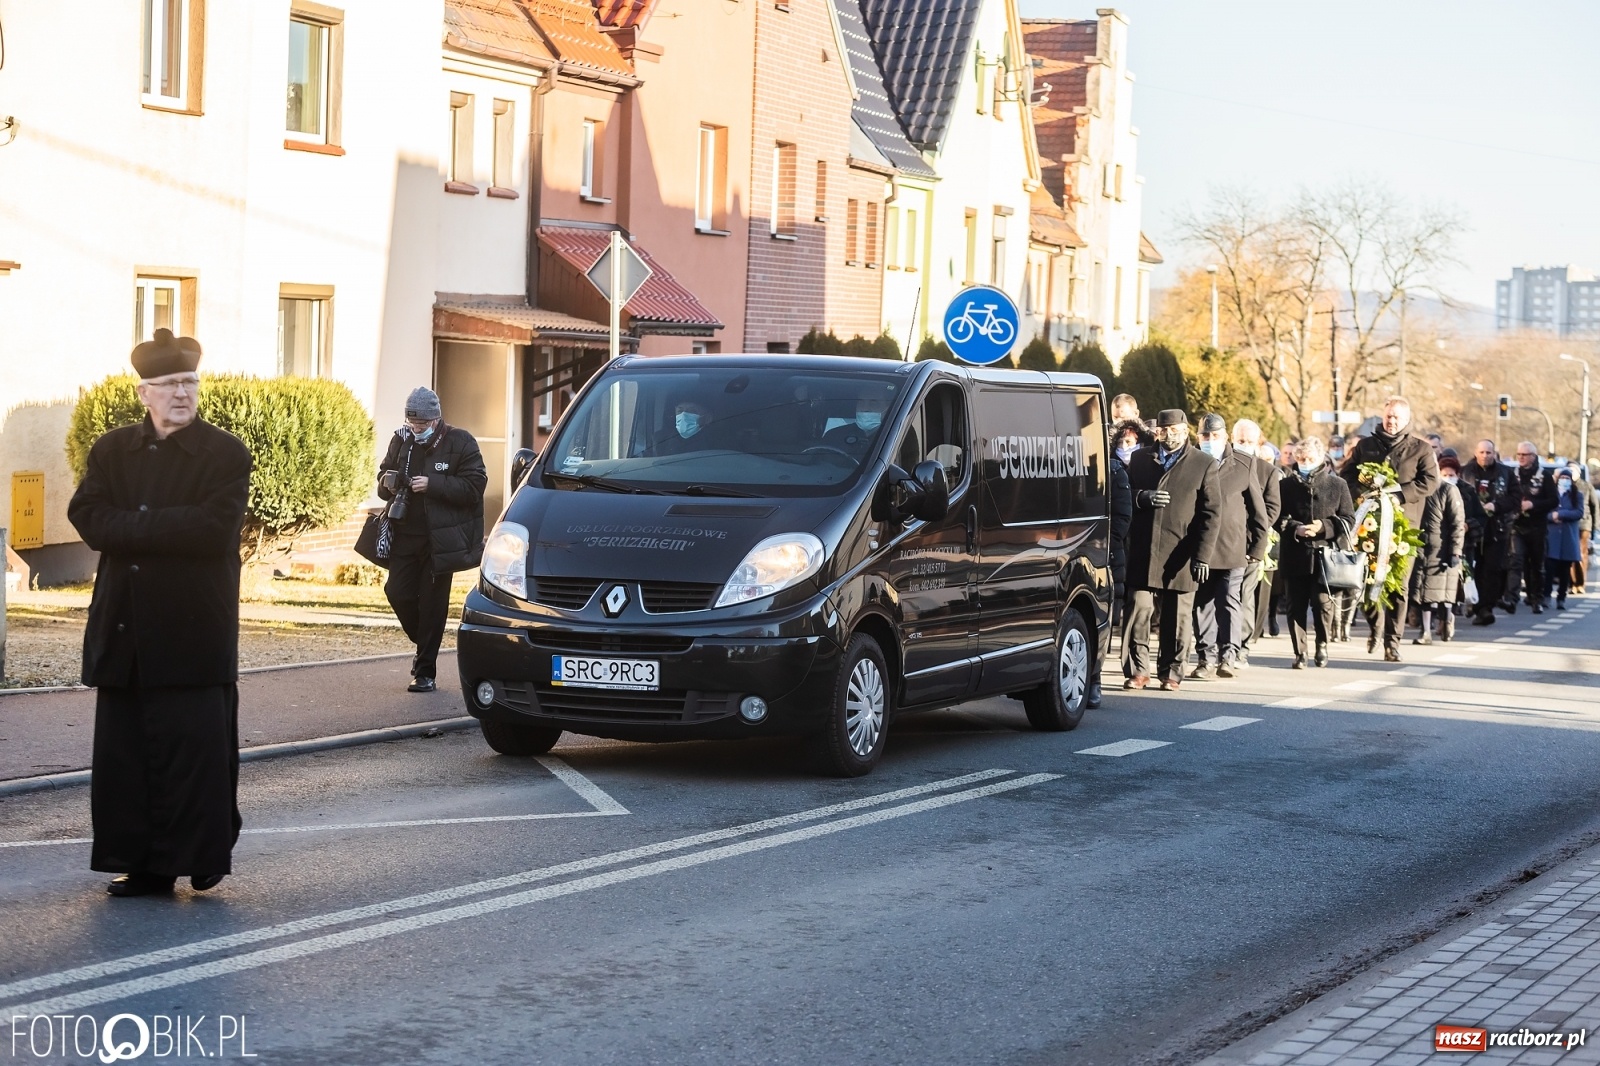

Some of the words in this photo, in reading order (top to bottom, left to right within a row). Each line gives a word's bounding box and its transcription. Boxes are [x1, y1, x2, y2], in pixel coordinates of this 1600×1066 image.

[622, 525, 728, 540] POGRZEBOWE
[564, 659, 603, 680] SRC
[609, 661, 655, 683] 9RC3
